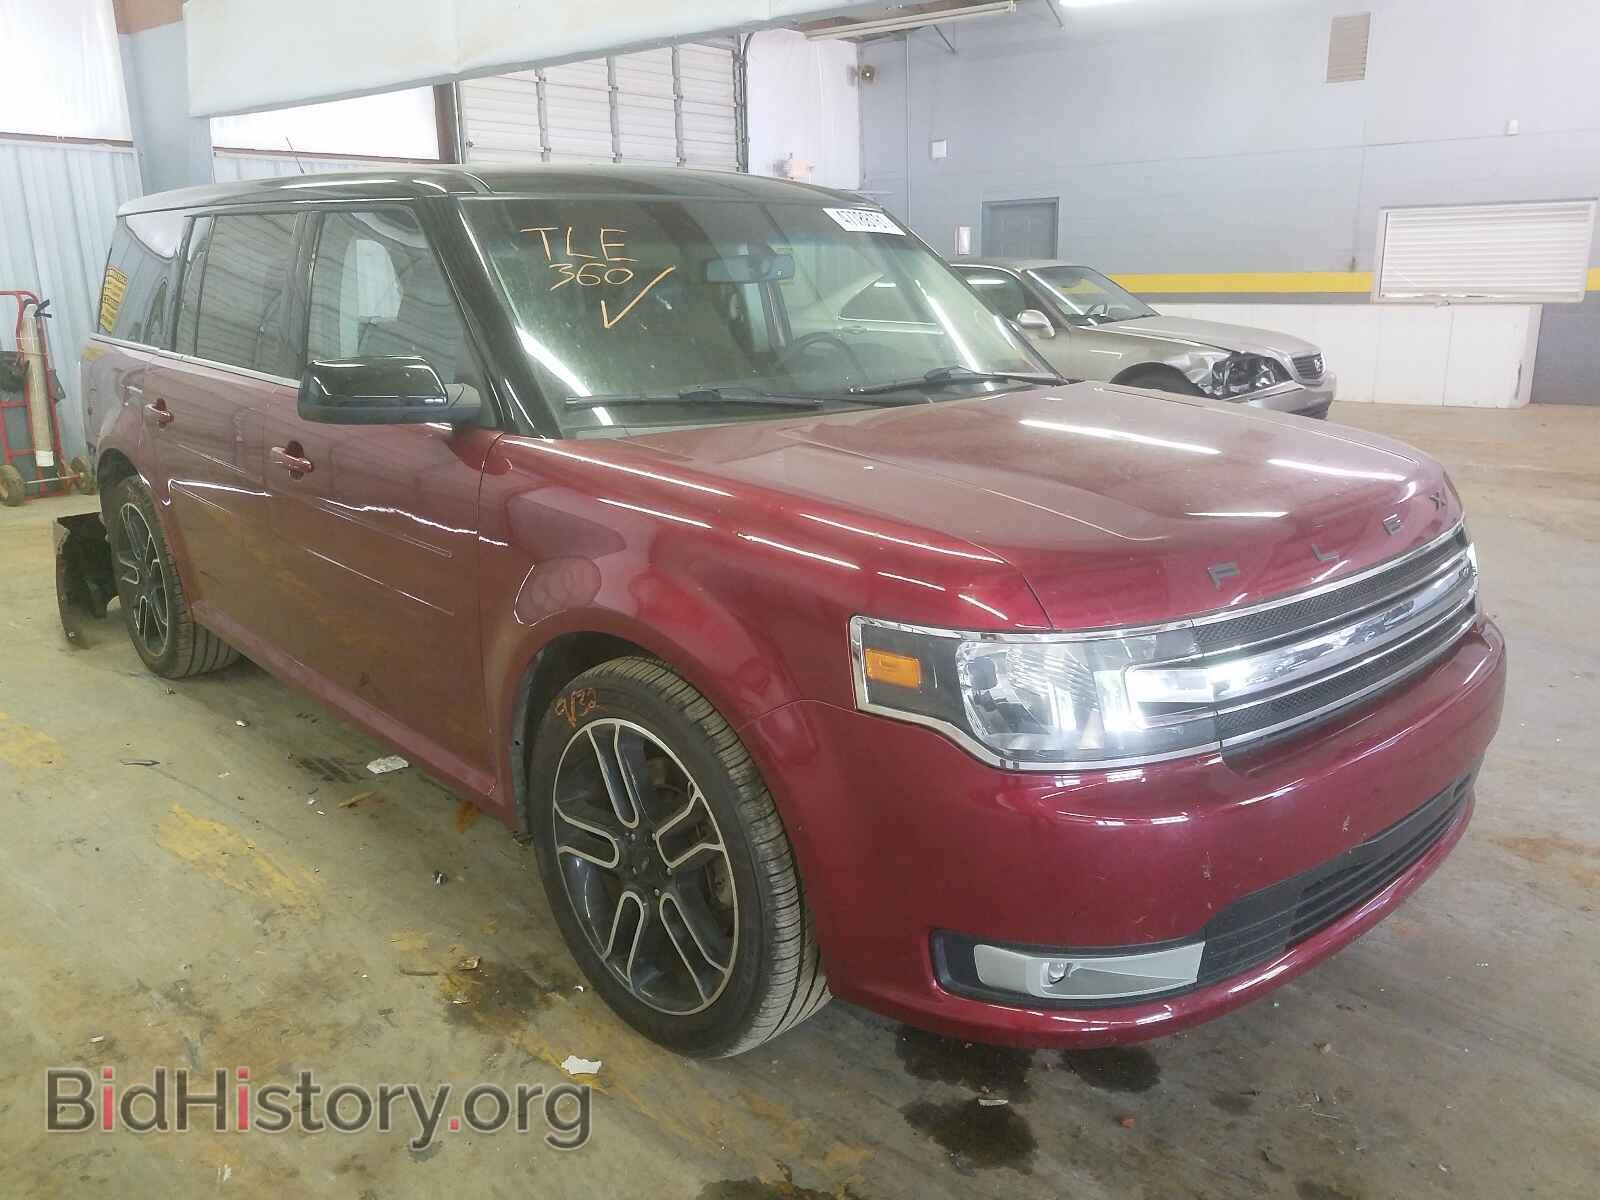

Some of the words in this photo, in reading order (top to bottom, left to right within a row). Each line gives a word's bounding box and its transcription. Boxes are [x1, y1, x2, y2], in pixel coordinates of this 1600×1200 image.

[520, 226, 640, 262] TLE
[549, 263, 634, 291] 360
[1208, 492, 1446, 590] FLEX
